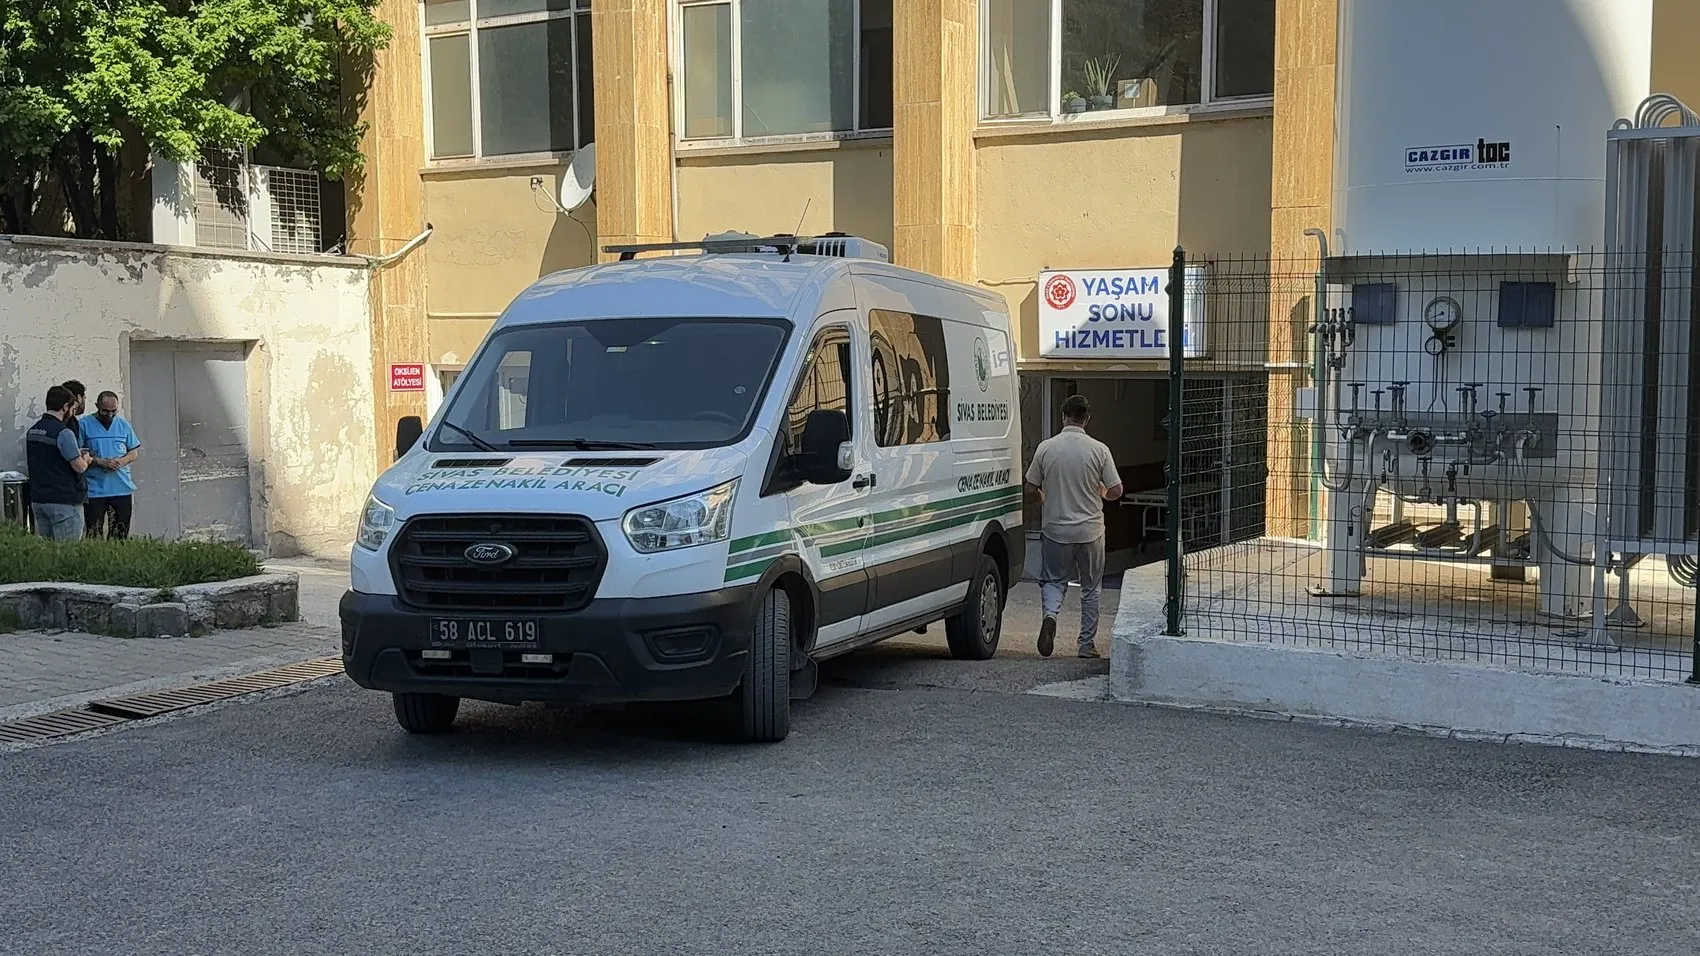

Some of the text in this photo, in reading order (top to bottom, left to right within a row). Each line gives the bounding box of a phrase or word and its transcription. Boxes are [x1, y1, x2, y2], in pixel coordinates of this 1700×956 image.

[1408, 148, 1470, 162] CAZGIR
[1082, 276, 1159, 300] YAŞAM
[1088, 303, 1153, 322] SONU
[1055, 326, 1189, 349] HİZMETLEİ
[394, 366, 421, 376] OKSİJEN
[393, 377, 422, 387] ATÖLYESİ
[957, 397, 1009, 422] SİVAS BELEDİYESİ
[417, 465, 641, 481] SİVAS BELEDİYESİ
[405, 476, 627, 498] CENAZE NAKİL ARACI
[472, 546, 500, 559] Ford
[440, 621, 536, 641] 58 ACL 619
